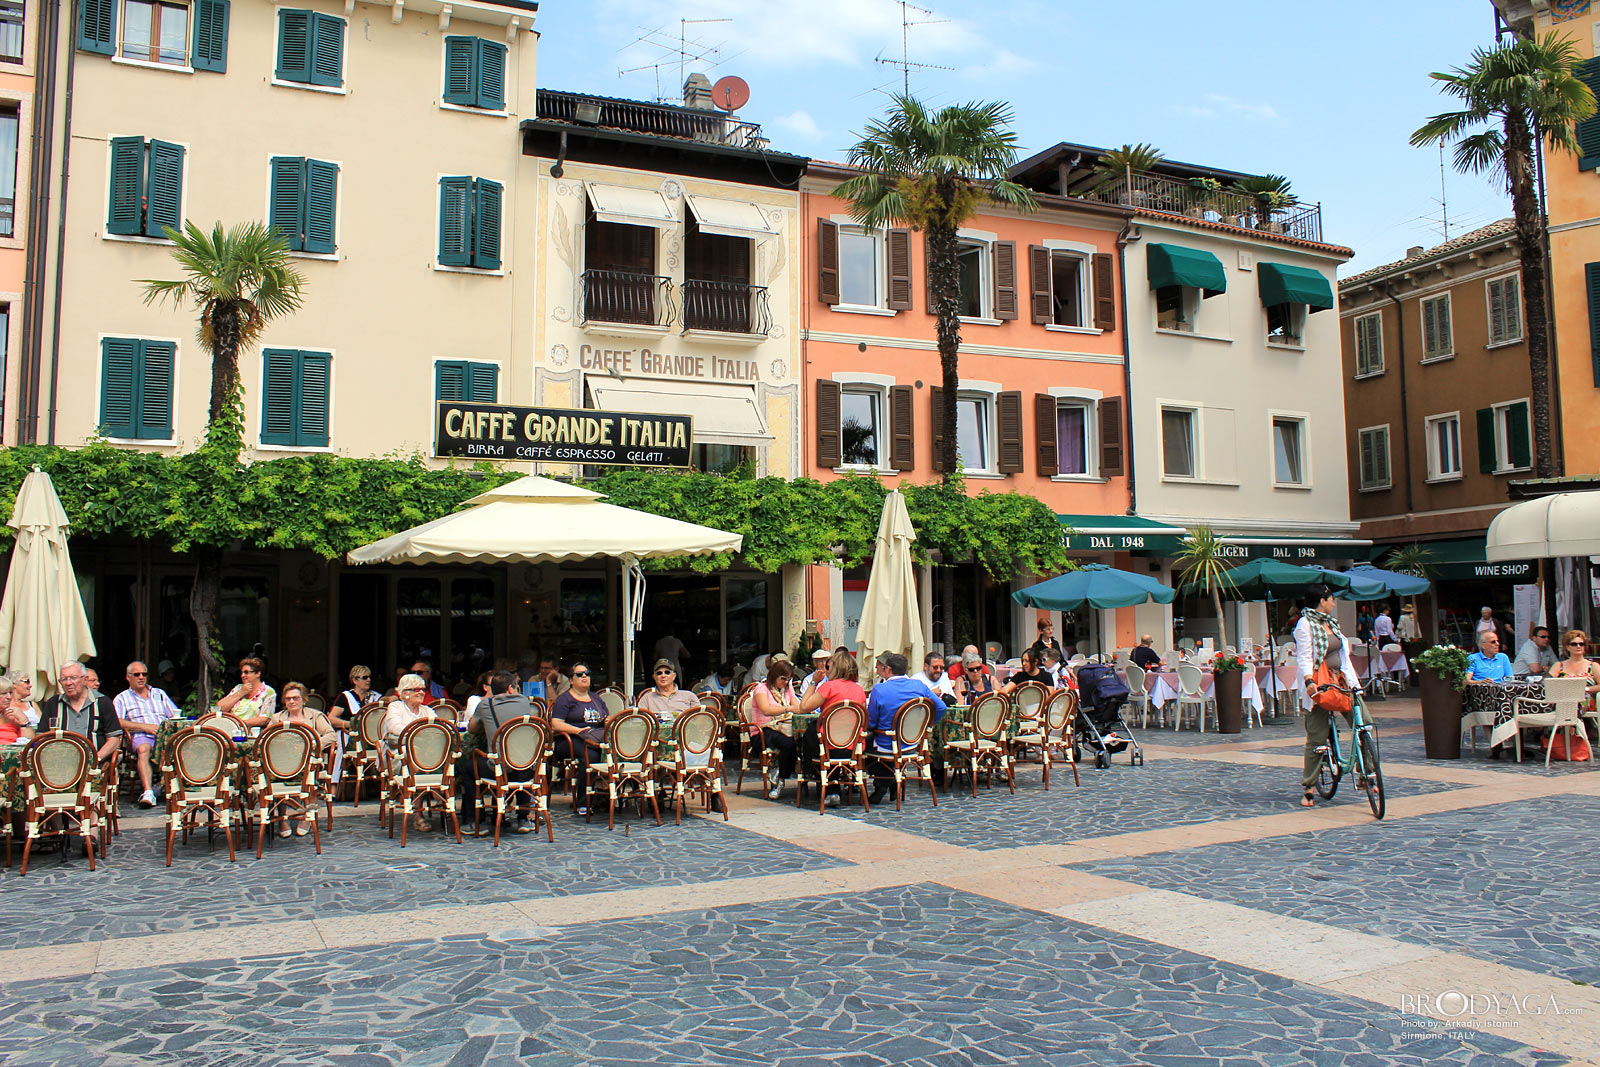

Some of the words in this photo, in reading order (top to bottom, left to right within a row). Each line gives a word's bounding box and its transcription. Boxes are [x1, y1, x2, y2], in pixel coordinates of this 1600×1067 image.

[640, 348, 705, 377] GRANDE
[711, 355, 760, 381] ITALIA
[524, 412, 615, 446] GRANDE
[620, 416, 687, 449] ITALIA
[467, 443, 505, 456] BIRRA
[555, 447, 616, 460] ESPRESSO
[626, 450, 663, 462] GELATI
[1090, 536, 1114, 548] DAL
[1121, 536, 1145, 548] 1948
[1273, 547, 1291, 557] DAL
[1297, 547, 1316, 558] 1948
[1474, 565, 1500, 576] WINE
[1501, 564, 1530, 575] SHOP
